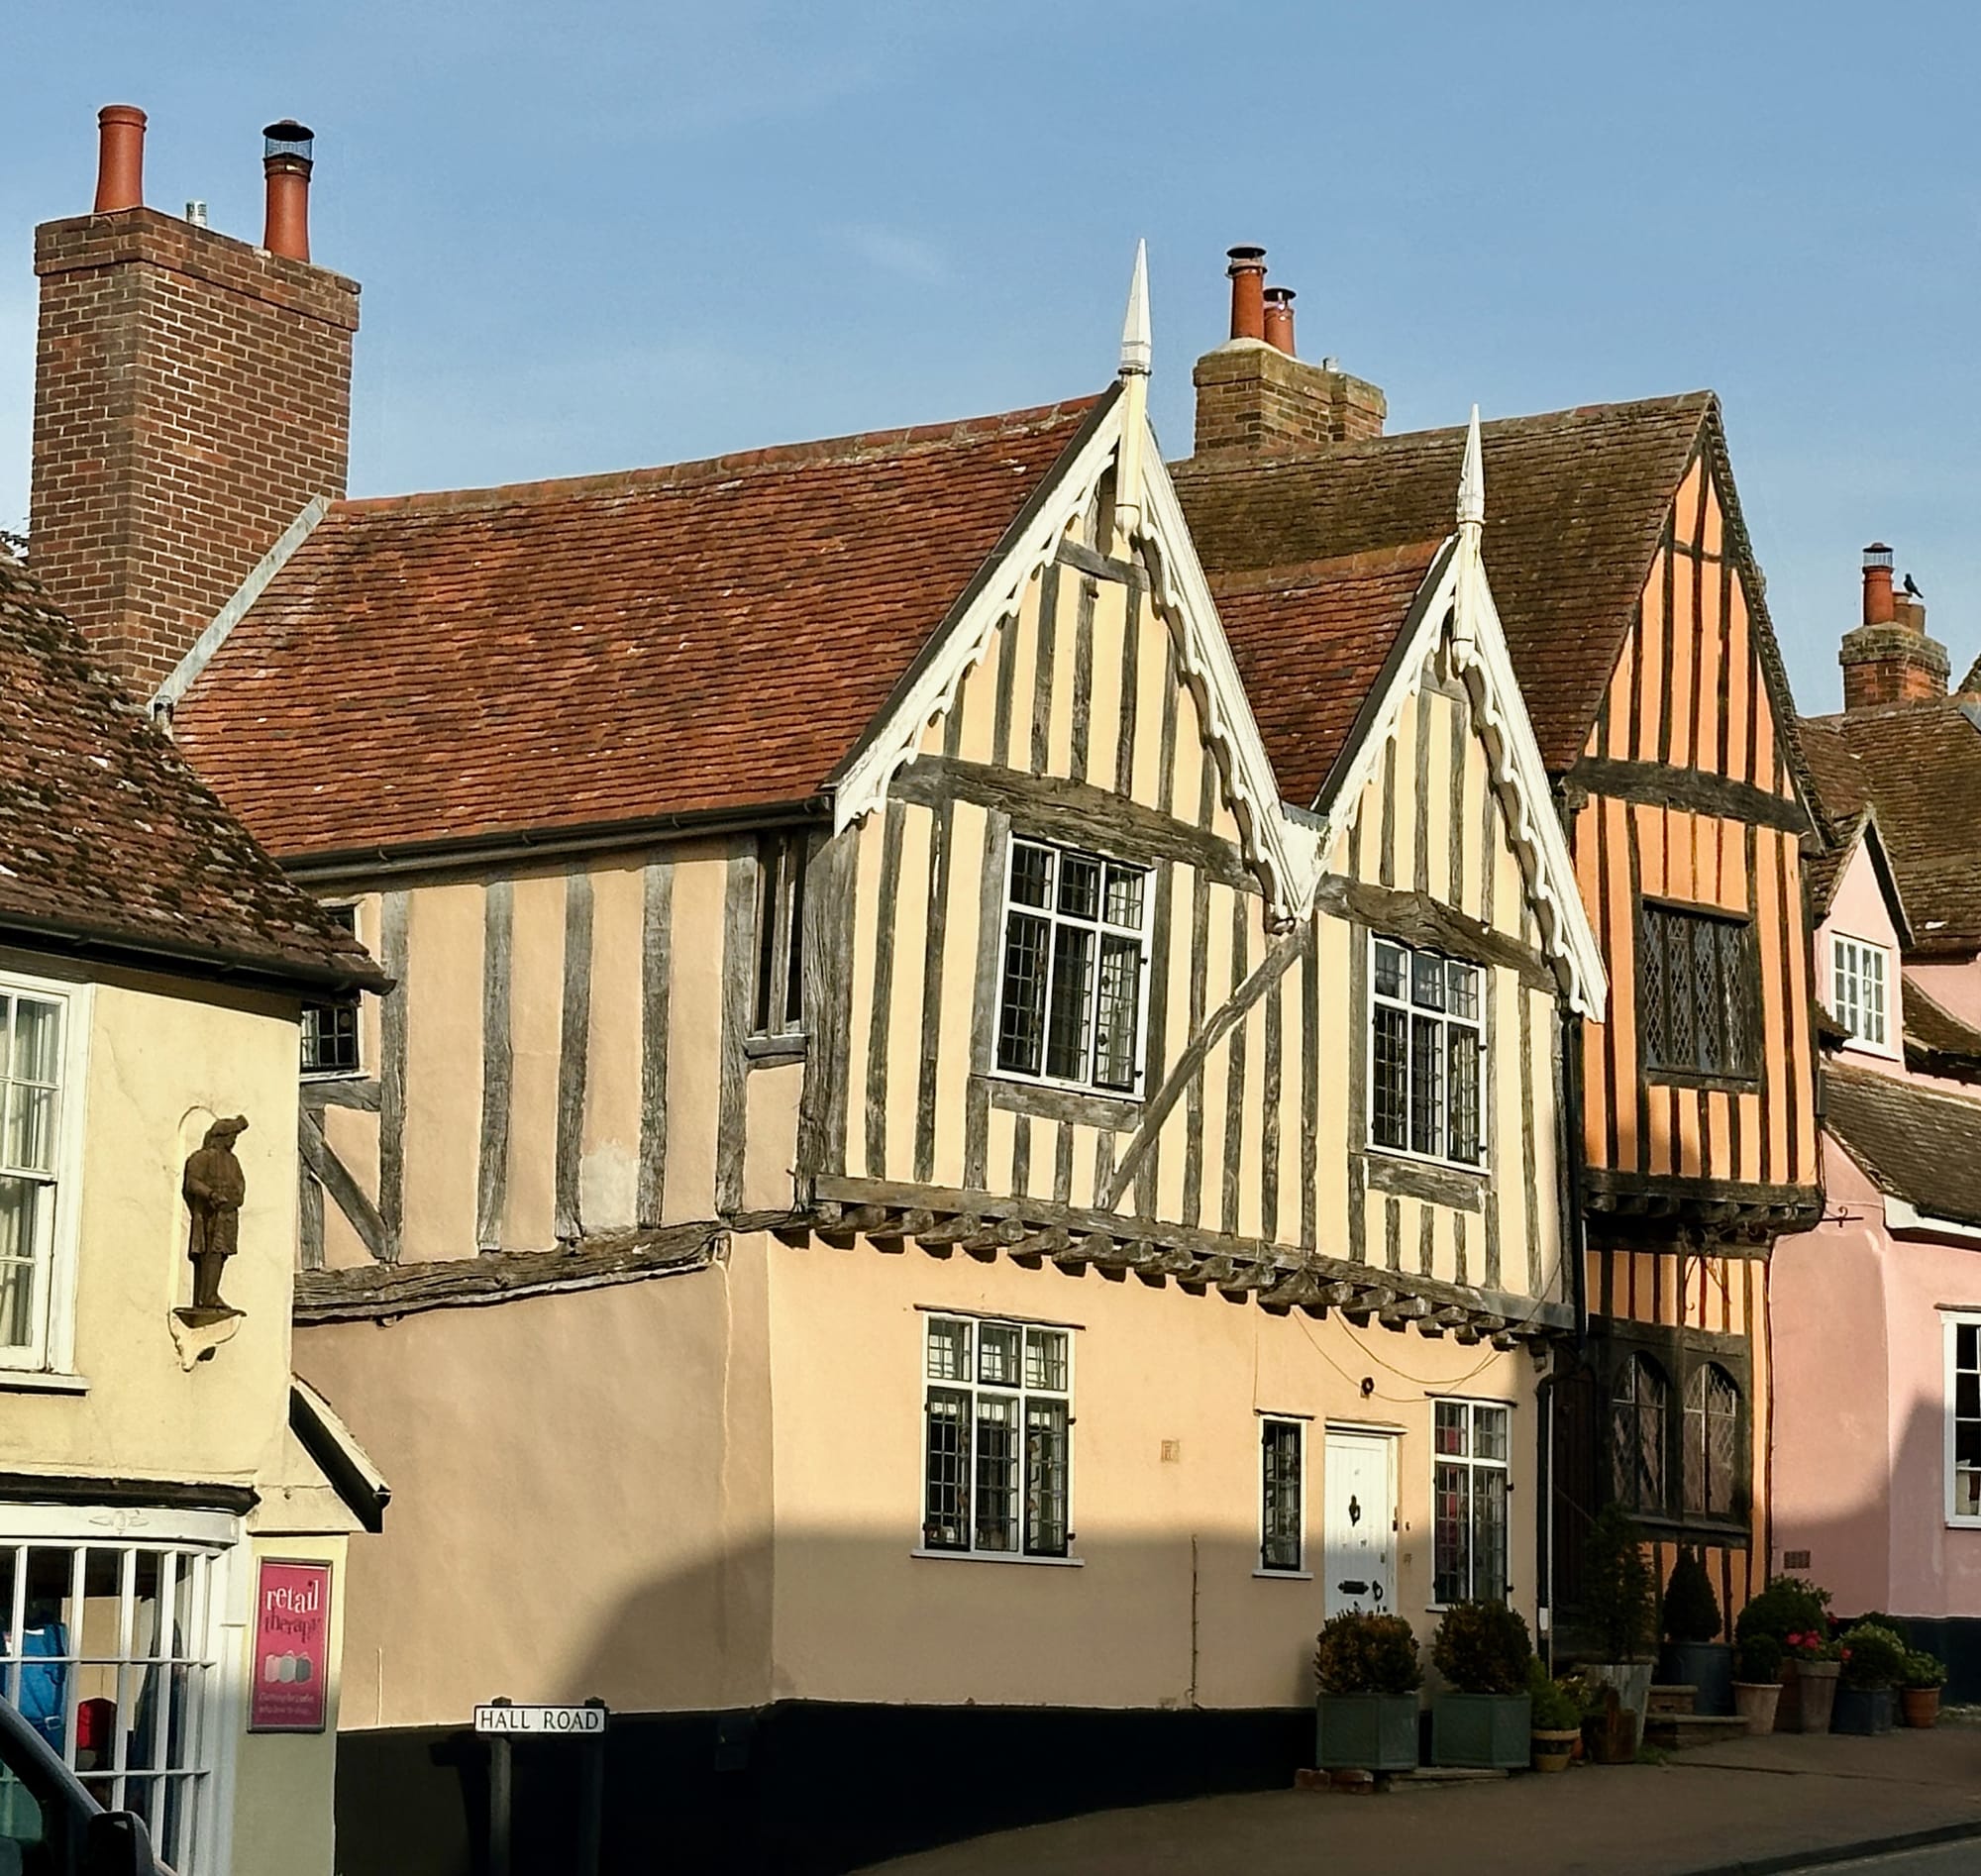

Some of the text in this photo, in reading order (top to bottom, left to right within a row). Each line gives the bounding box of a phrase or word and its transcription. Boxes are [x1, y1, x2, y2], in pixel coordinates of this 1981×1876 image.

[266, 1579, 319, 1614] retail
[480, 1710, 599, 1730] HALL ROAD
